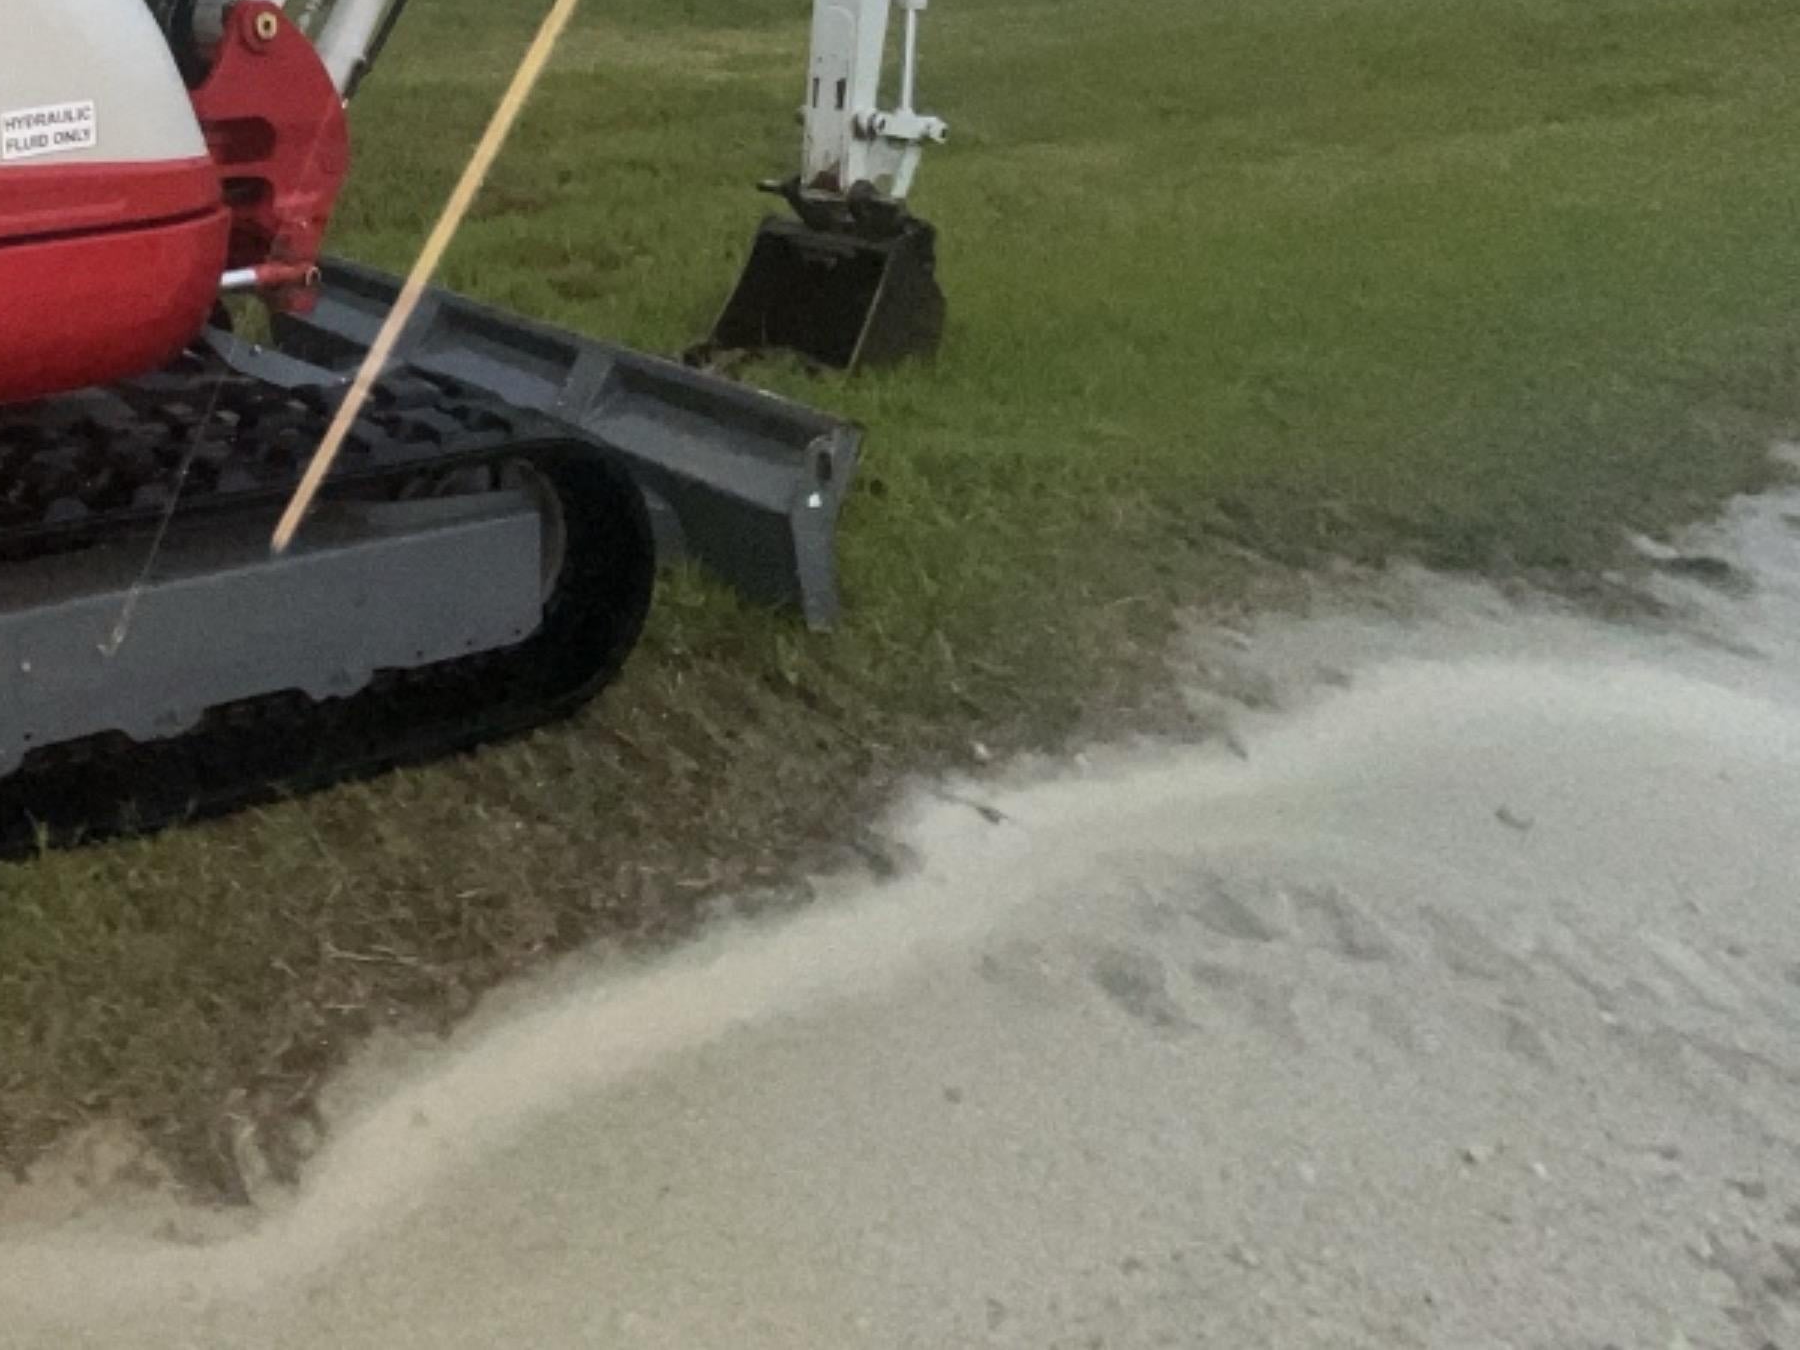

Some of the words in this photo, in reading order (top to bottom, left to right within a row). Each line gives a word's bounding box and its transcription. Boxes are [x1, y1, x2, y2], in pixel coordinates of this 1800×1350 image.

[5, 105, 91, 131] HYDRAULIC
[5, 134, 48, 153] FLUID
[53, 128, 91, 145] ONLY
